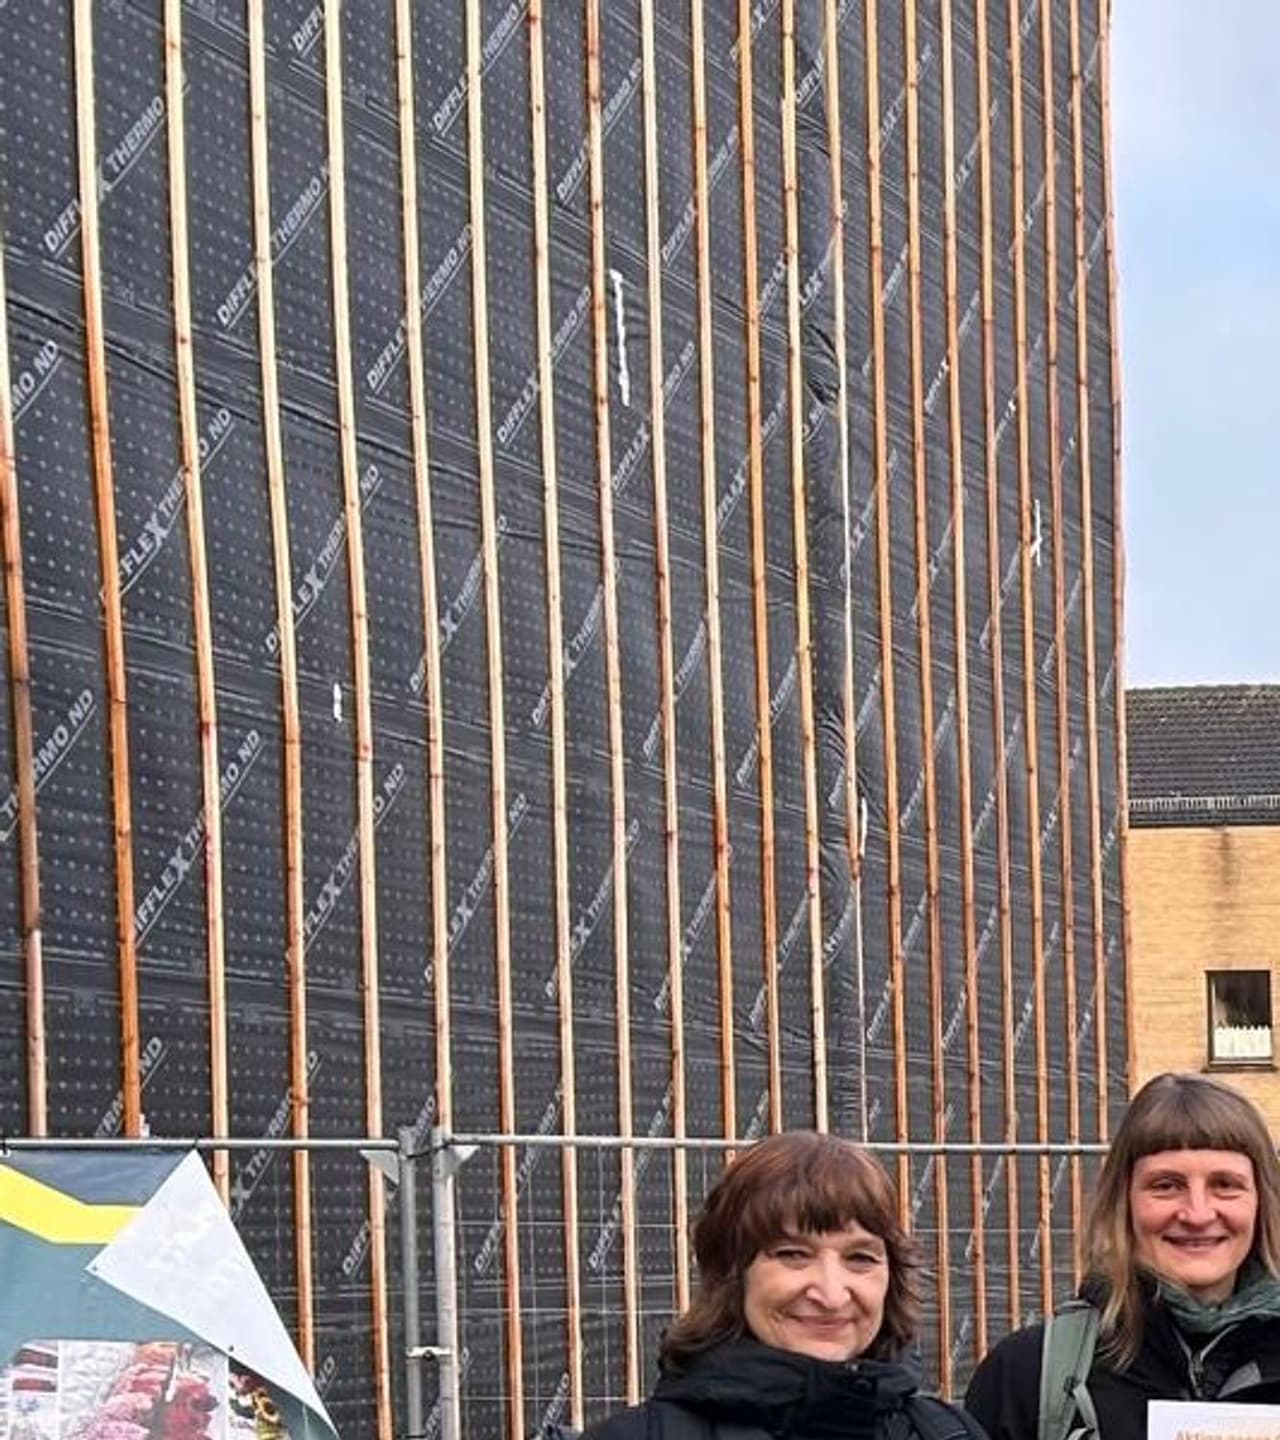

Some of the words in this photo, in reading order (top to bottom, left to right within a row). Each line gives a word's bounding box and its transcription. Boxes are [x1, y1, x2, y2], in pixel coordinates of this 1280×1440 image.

[33, 339, 60, 377] ND
[207, 407, 231, 441] ND
[67, 689, 94, 727] ND
[238, 728, 260, 762] ND
[383, 763, 405, 796] ND
